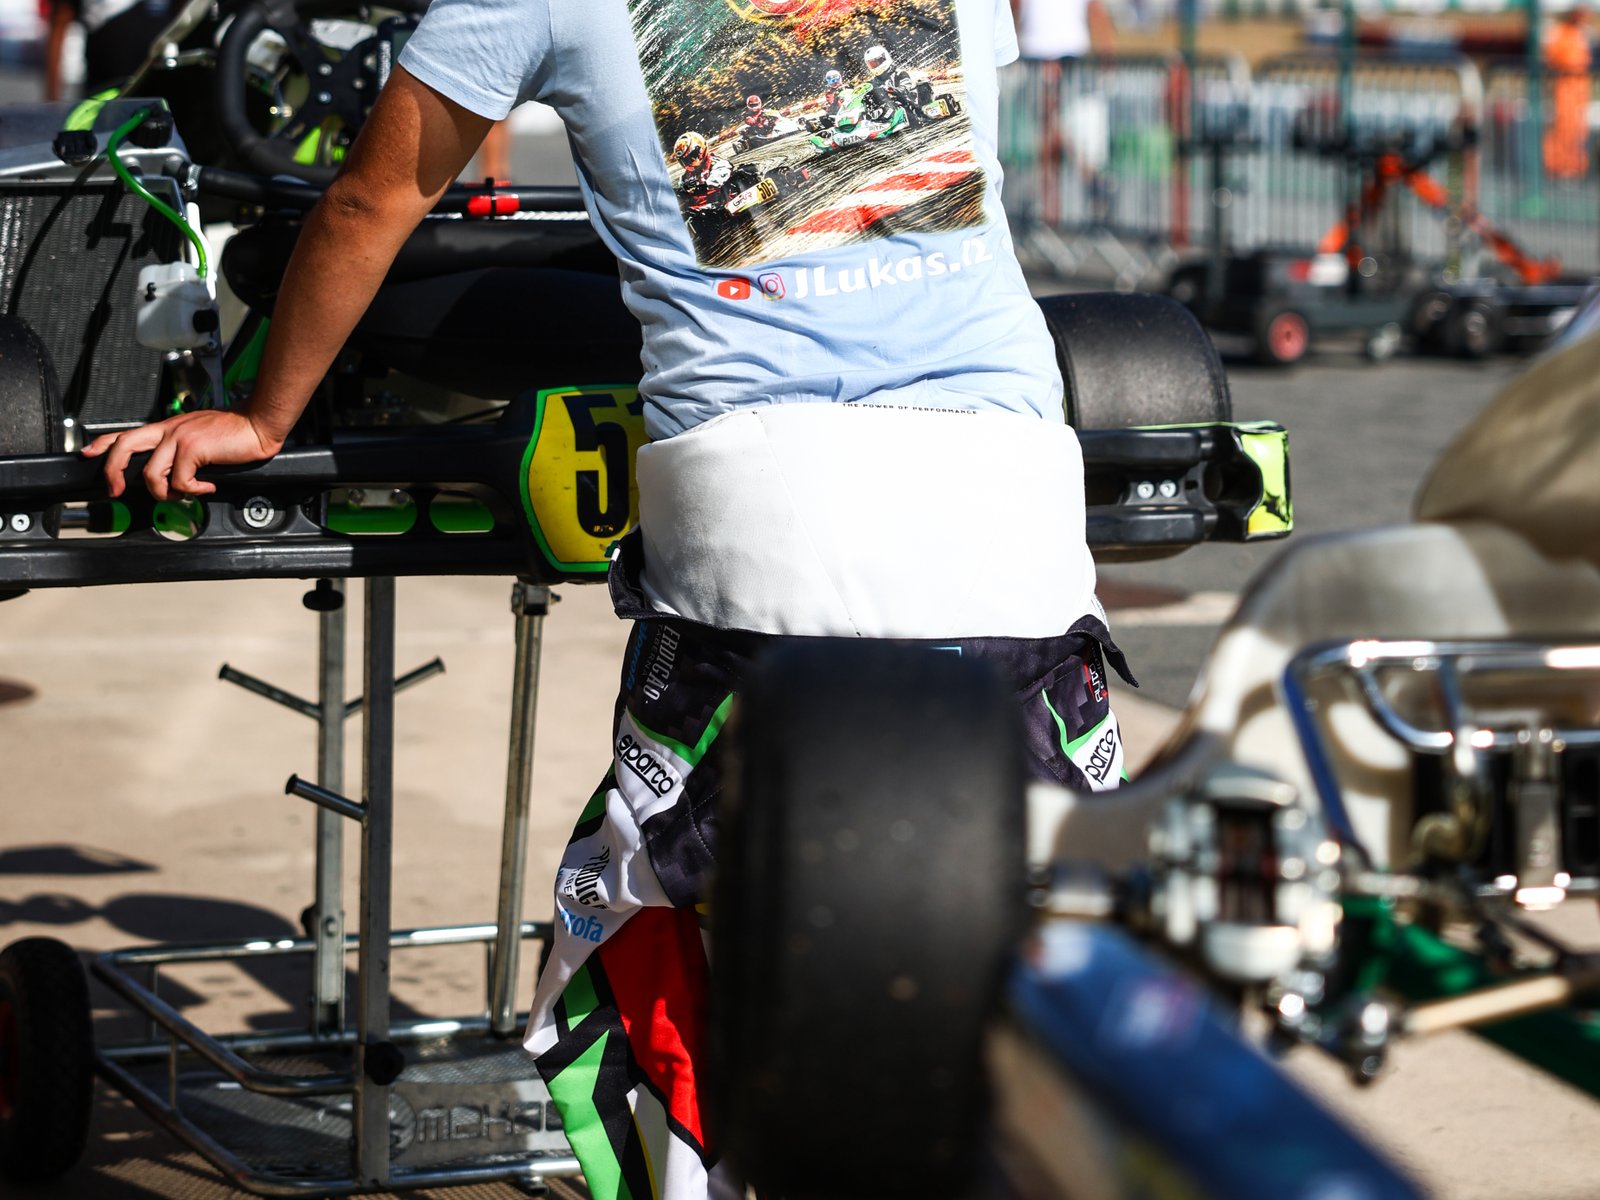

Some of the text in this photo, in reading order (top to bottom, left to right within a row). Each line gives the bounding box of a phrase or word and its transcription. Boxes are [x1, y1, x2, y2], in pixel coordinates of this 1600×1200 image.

[756, 179, 777, 200] 505
[912, 406, 978, 415] PERFORMANCE
[561, 393, 643, 539] 5
[643, 625, 681, 701] ERDIGÃO
[617, 734, 674, 795] sparco
[1085, 728, 1114, 784] parco
